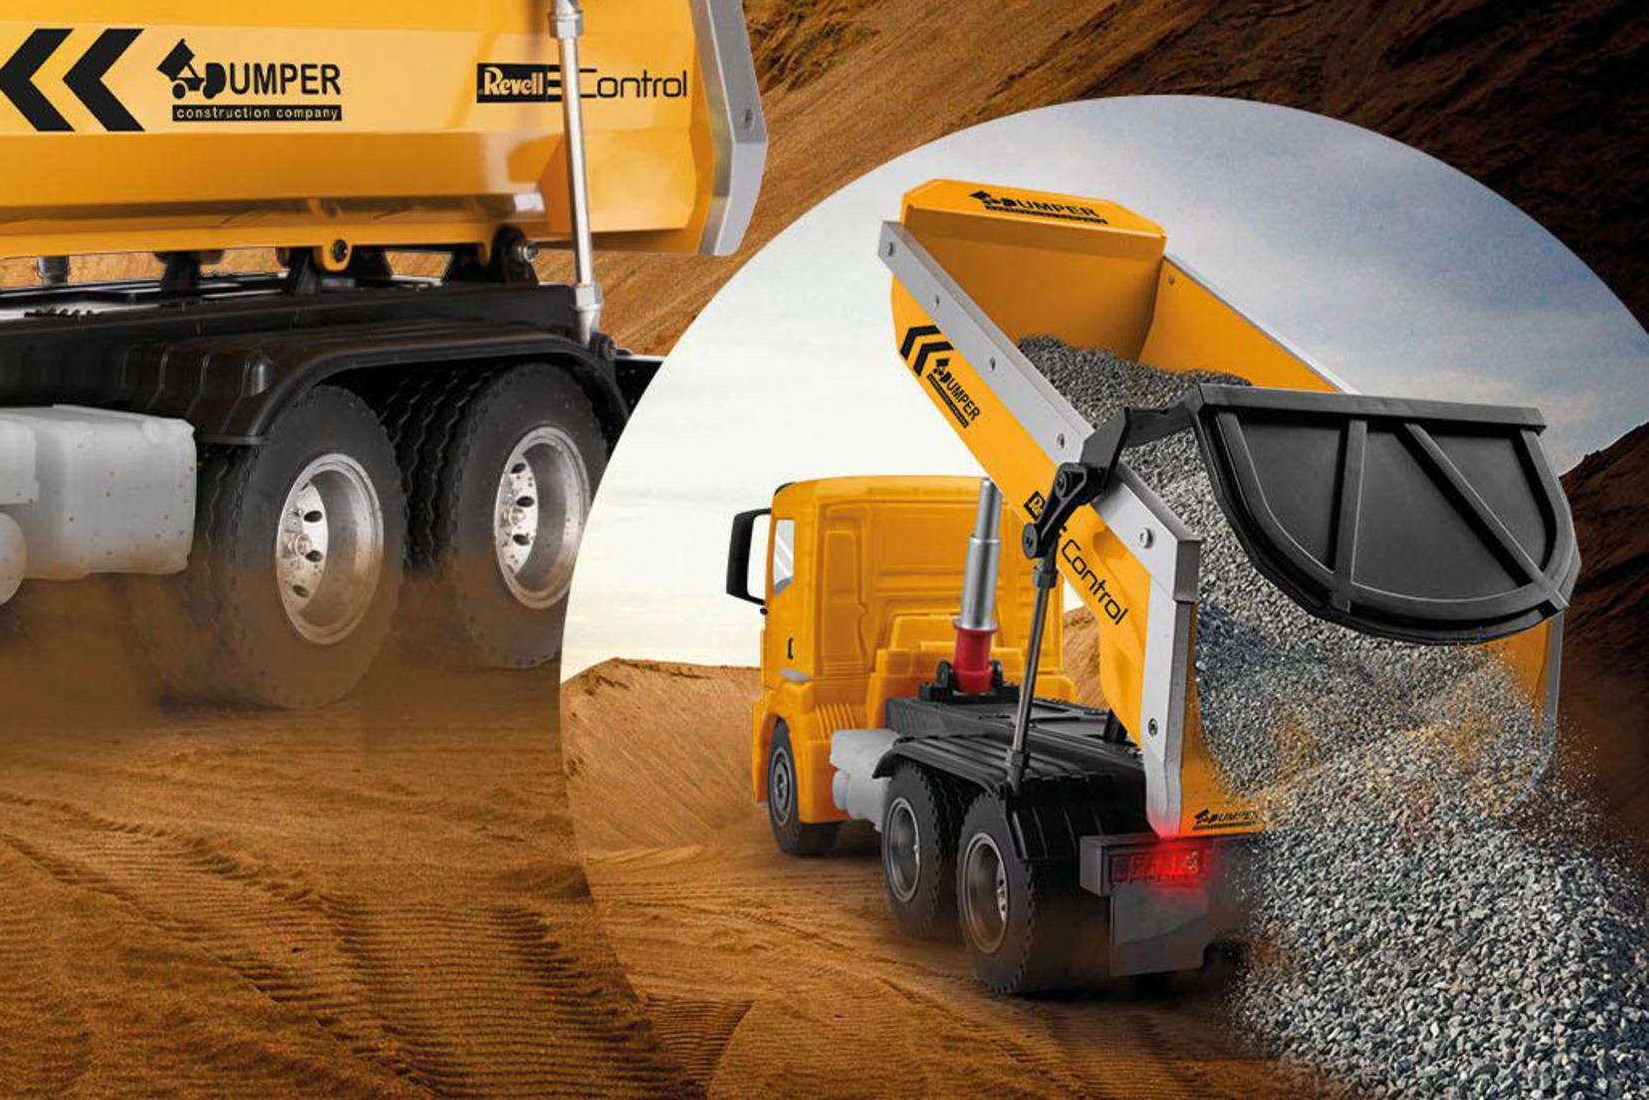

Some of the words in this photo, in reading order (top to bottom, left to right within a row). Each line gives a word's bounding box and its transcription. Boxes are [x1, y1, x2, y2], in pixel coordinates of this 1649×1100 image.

[176, 106, 271, 119] construction
[276, 107, 339, 121] company
[1061, 539, 1129, 626] Control
